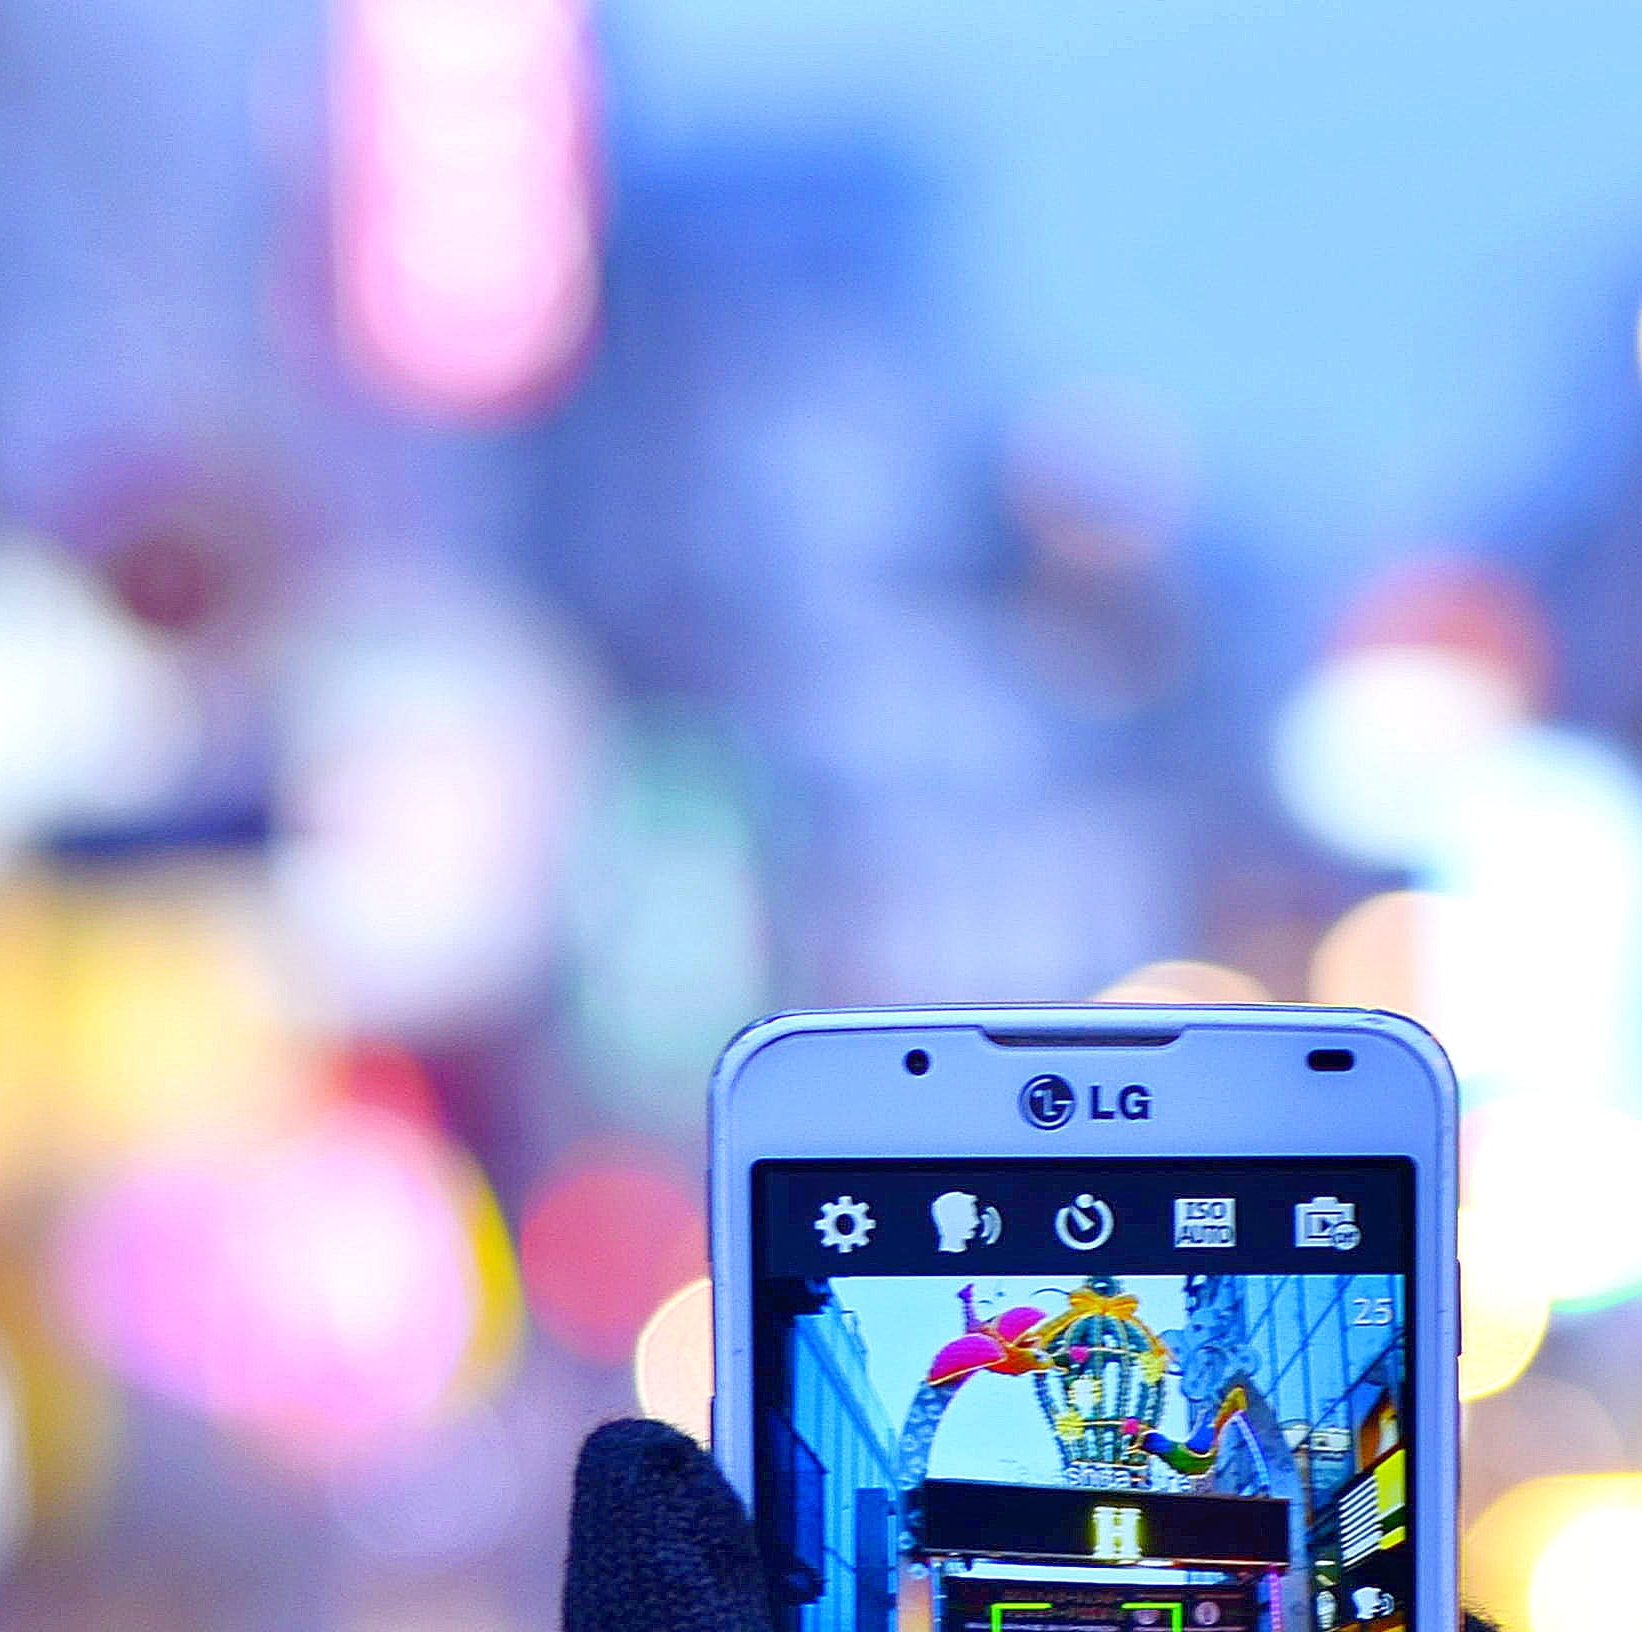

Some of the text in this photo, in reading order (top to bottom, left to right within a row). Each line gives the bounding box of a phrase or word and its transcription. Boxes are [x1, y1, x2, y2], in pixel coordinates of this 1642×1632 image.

[1089, 1084, 1153, 1120] LG
[1185, 1201, 1226, 1219] ISO
[1177, 1225, 1231, 1244] AUTO
[1353, 1298, 1393, 1325] 25
